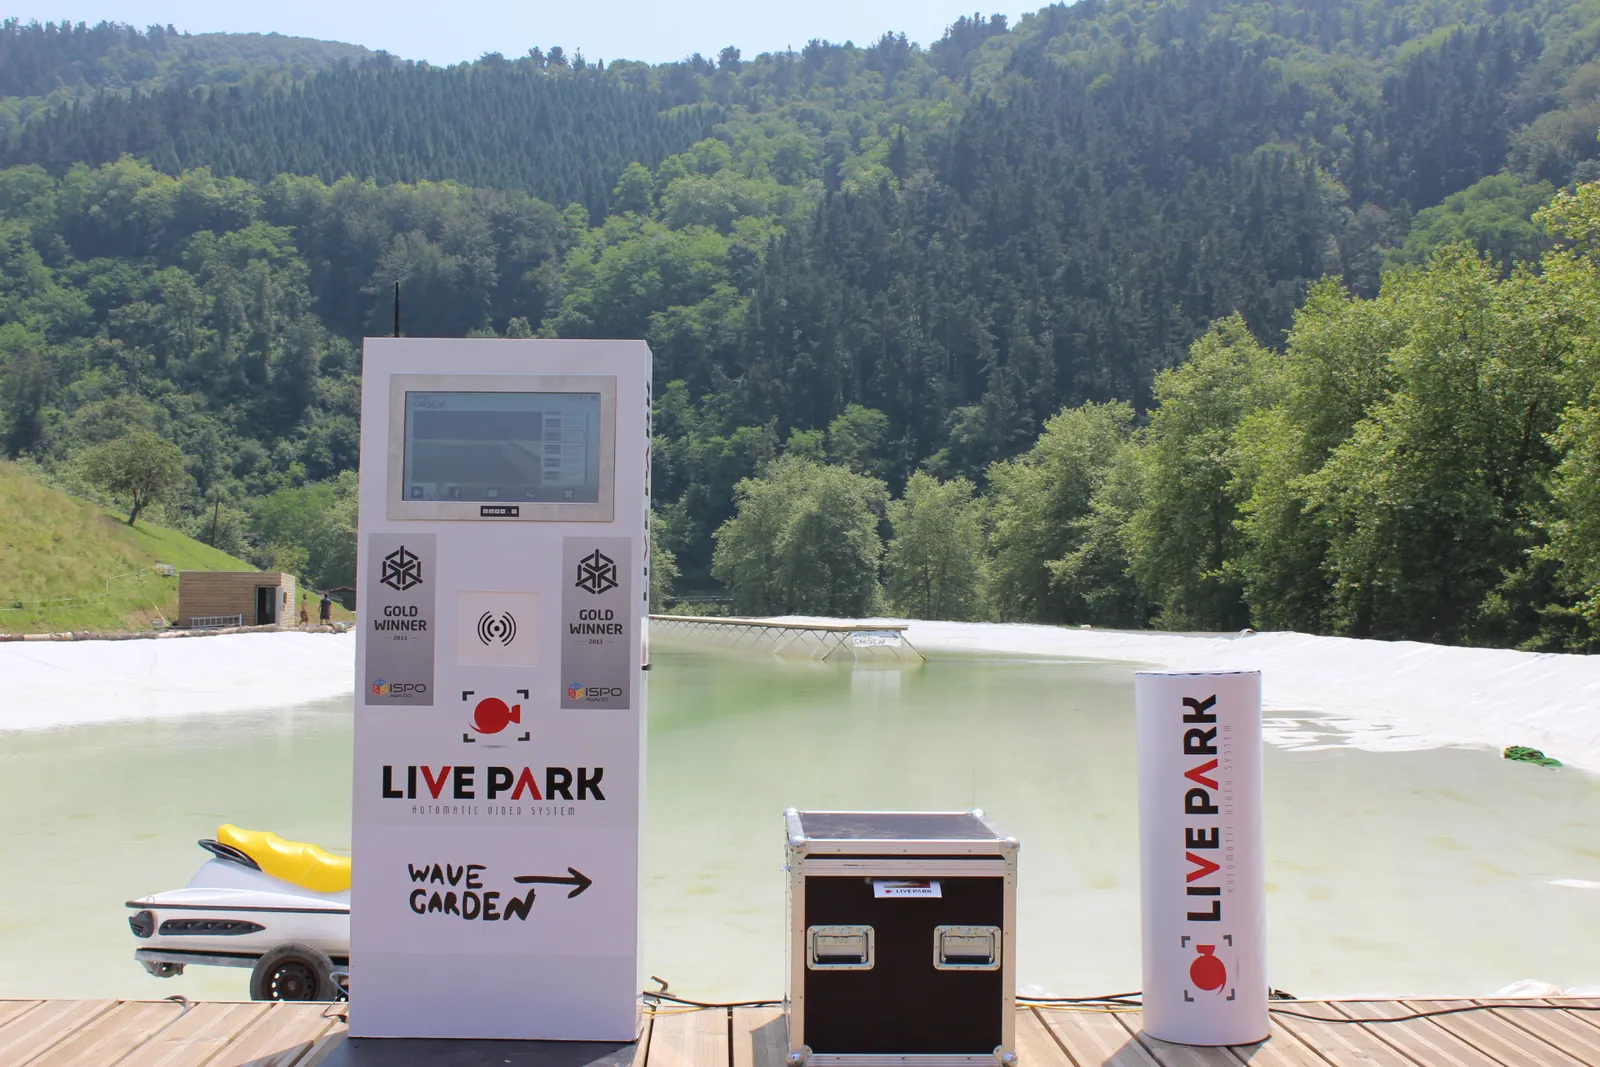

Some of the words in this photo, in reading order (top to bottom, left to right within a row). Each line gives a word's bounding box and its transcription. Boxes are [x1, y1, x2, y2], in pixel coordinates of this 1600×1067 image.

[384, 605, 418, 617] GOLD
[579, 609, 614, 621] GOLD
[374, 619, 427, 631] WINNER
[570, 623, 623, 635] WINNER
[389, 683, 427, 693] ISPO
[585, 687, 623, 697] ISPO
[1182, 694, 1219, 815] PARK
[382, 765, 476, 799] LIVE
[487, 766, 605, 801] PARK
[412, 805, 479, 815] AUTOMATIC
[487, 806, 522, 815] VIDEO
[531, 806, 576, 816] SYSTEM
[408, 863, 487, 889] WAVE
[1185, 826, 1221, 922] LIVE
[409, 888, 536, 921] GARDEN
